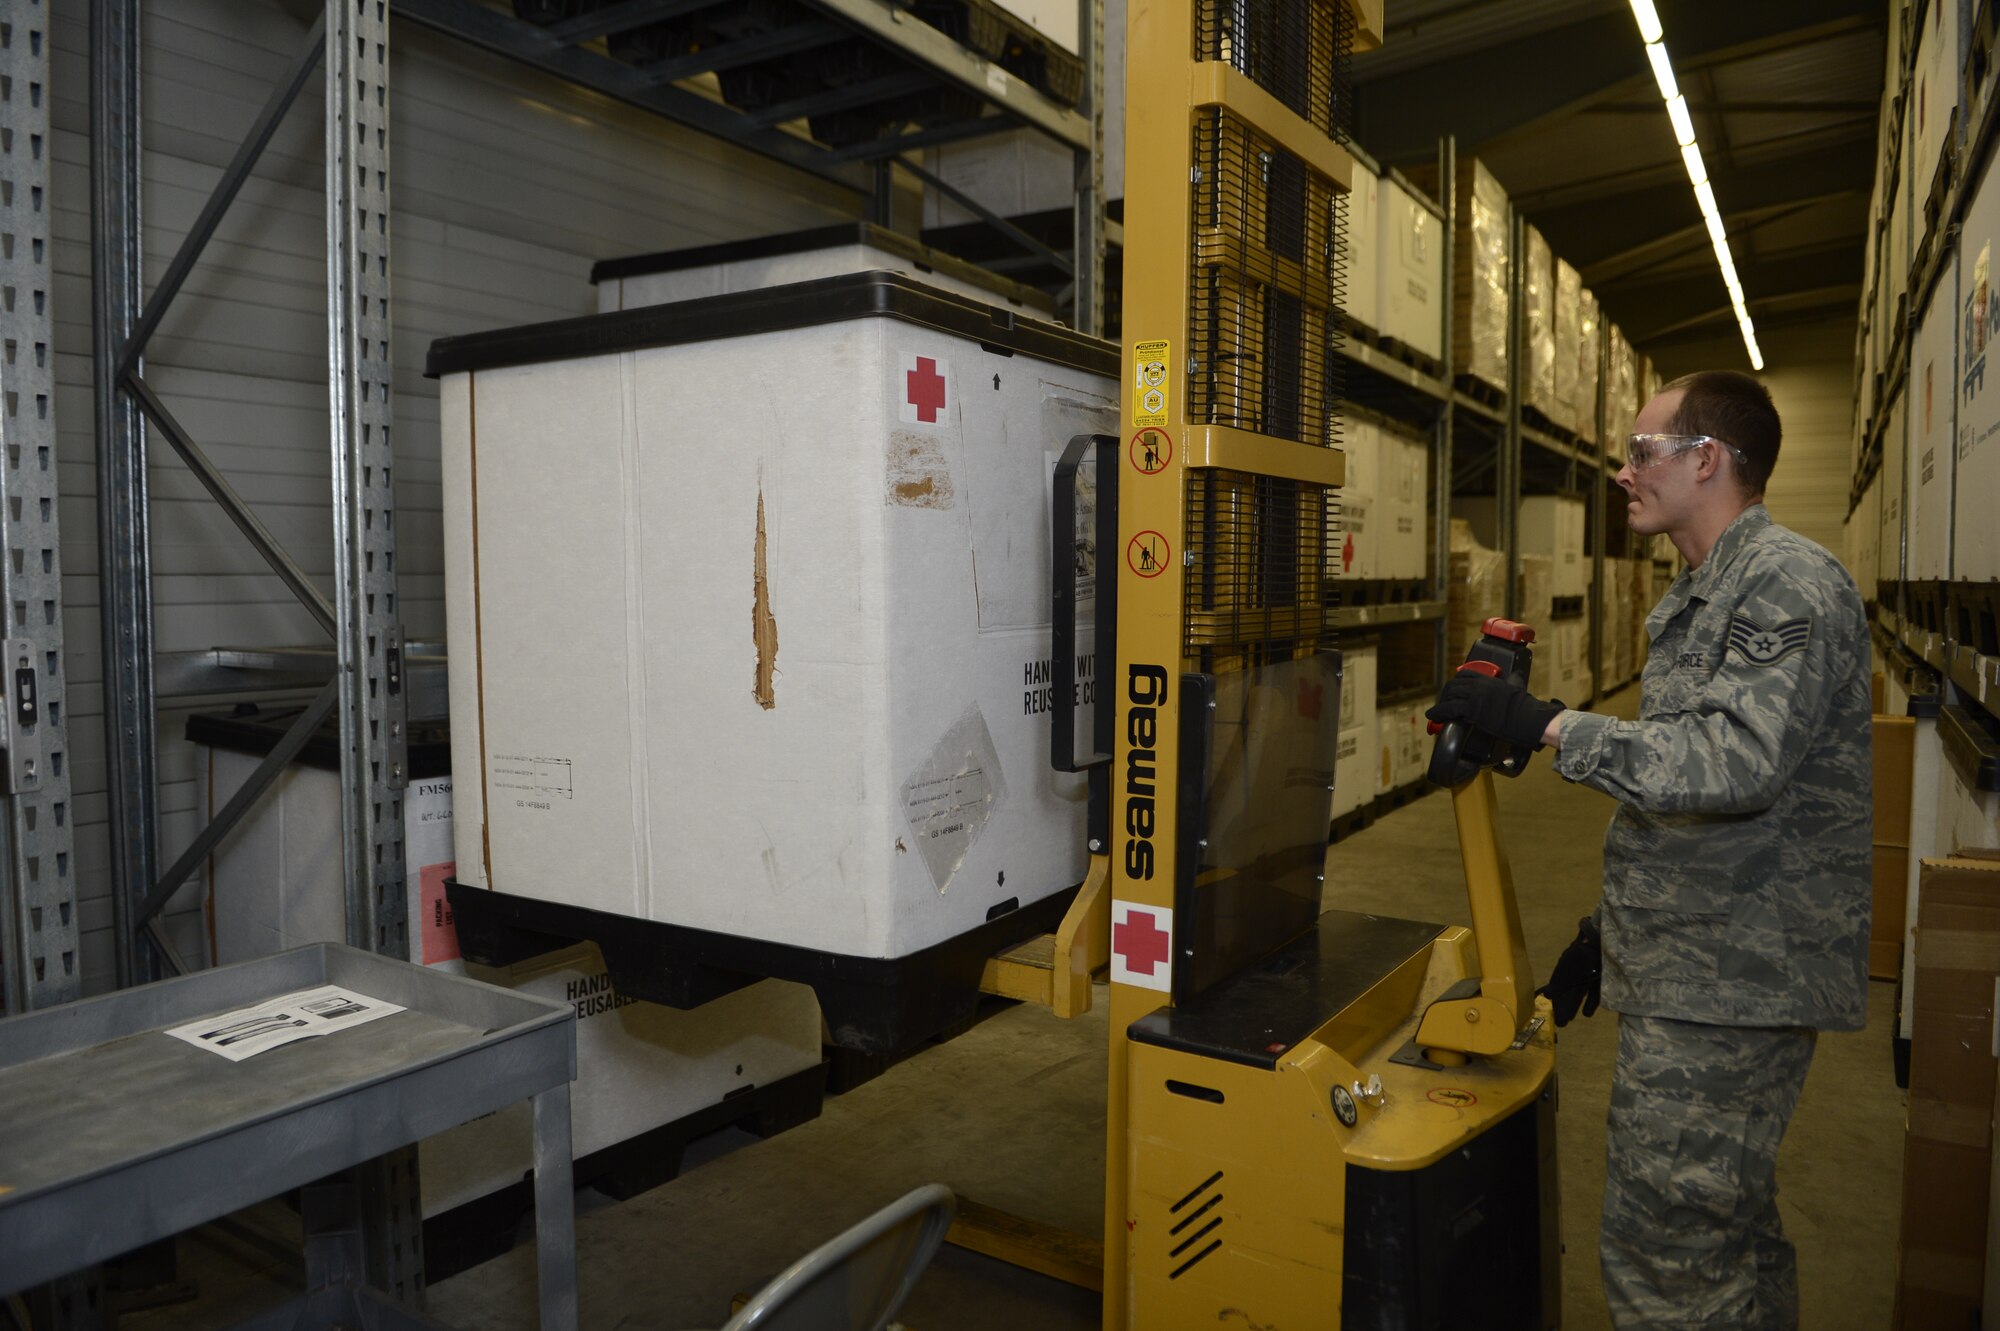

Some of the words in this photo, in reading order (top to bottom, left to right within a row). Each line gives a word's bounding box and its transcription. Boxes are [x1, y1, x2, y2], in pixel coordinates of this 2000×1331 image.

[1024, 660, 1051, 685] HAN
[1125, 663, 1168, 881] samag
[567, 972, 611, 1001] HAND
[574, 990, 639, 1019] EUSABL
